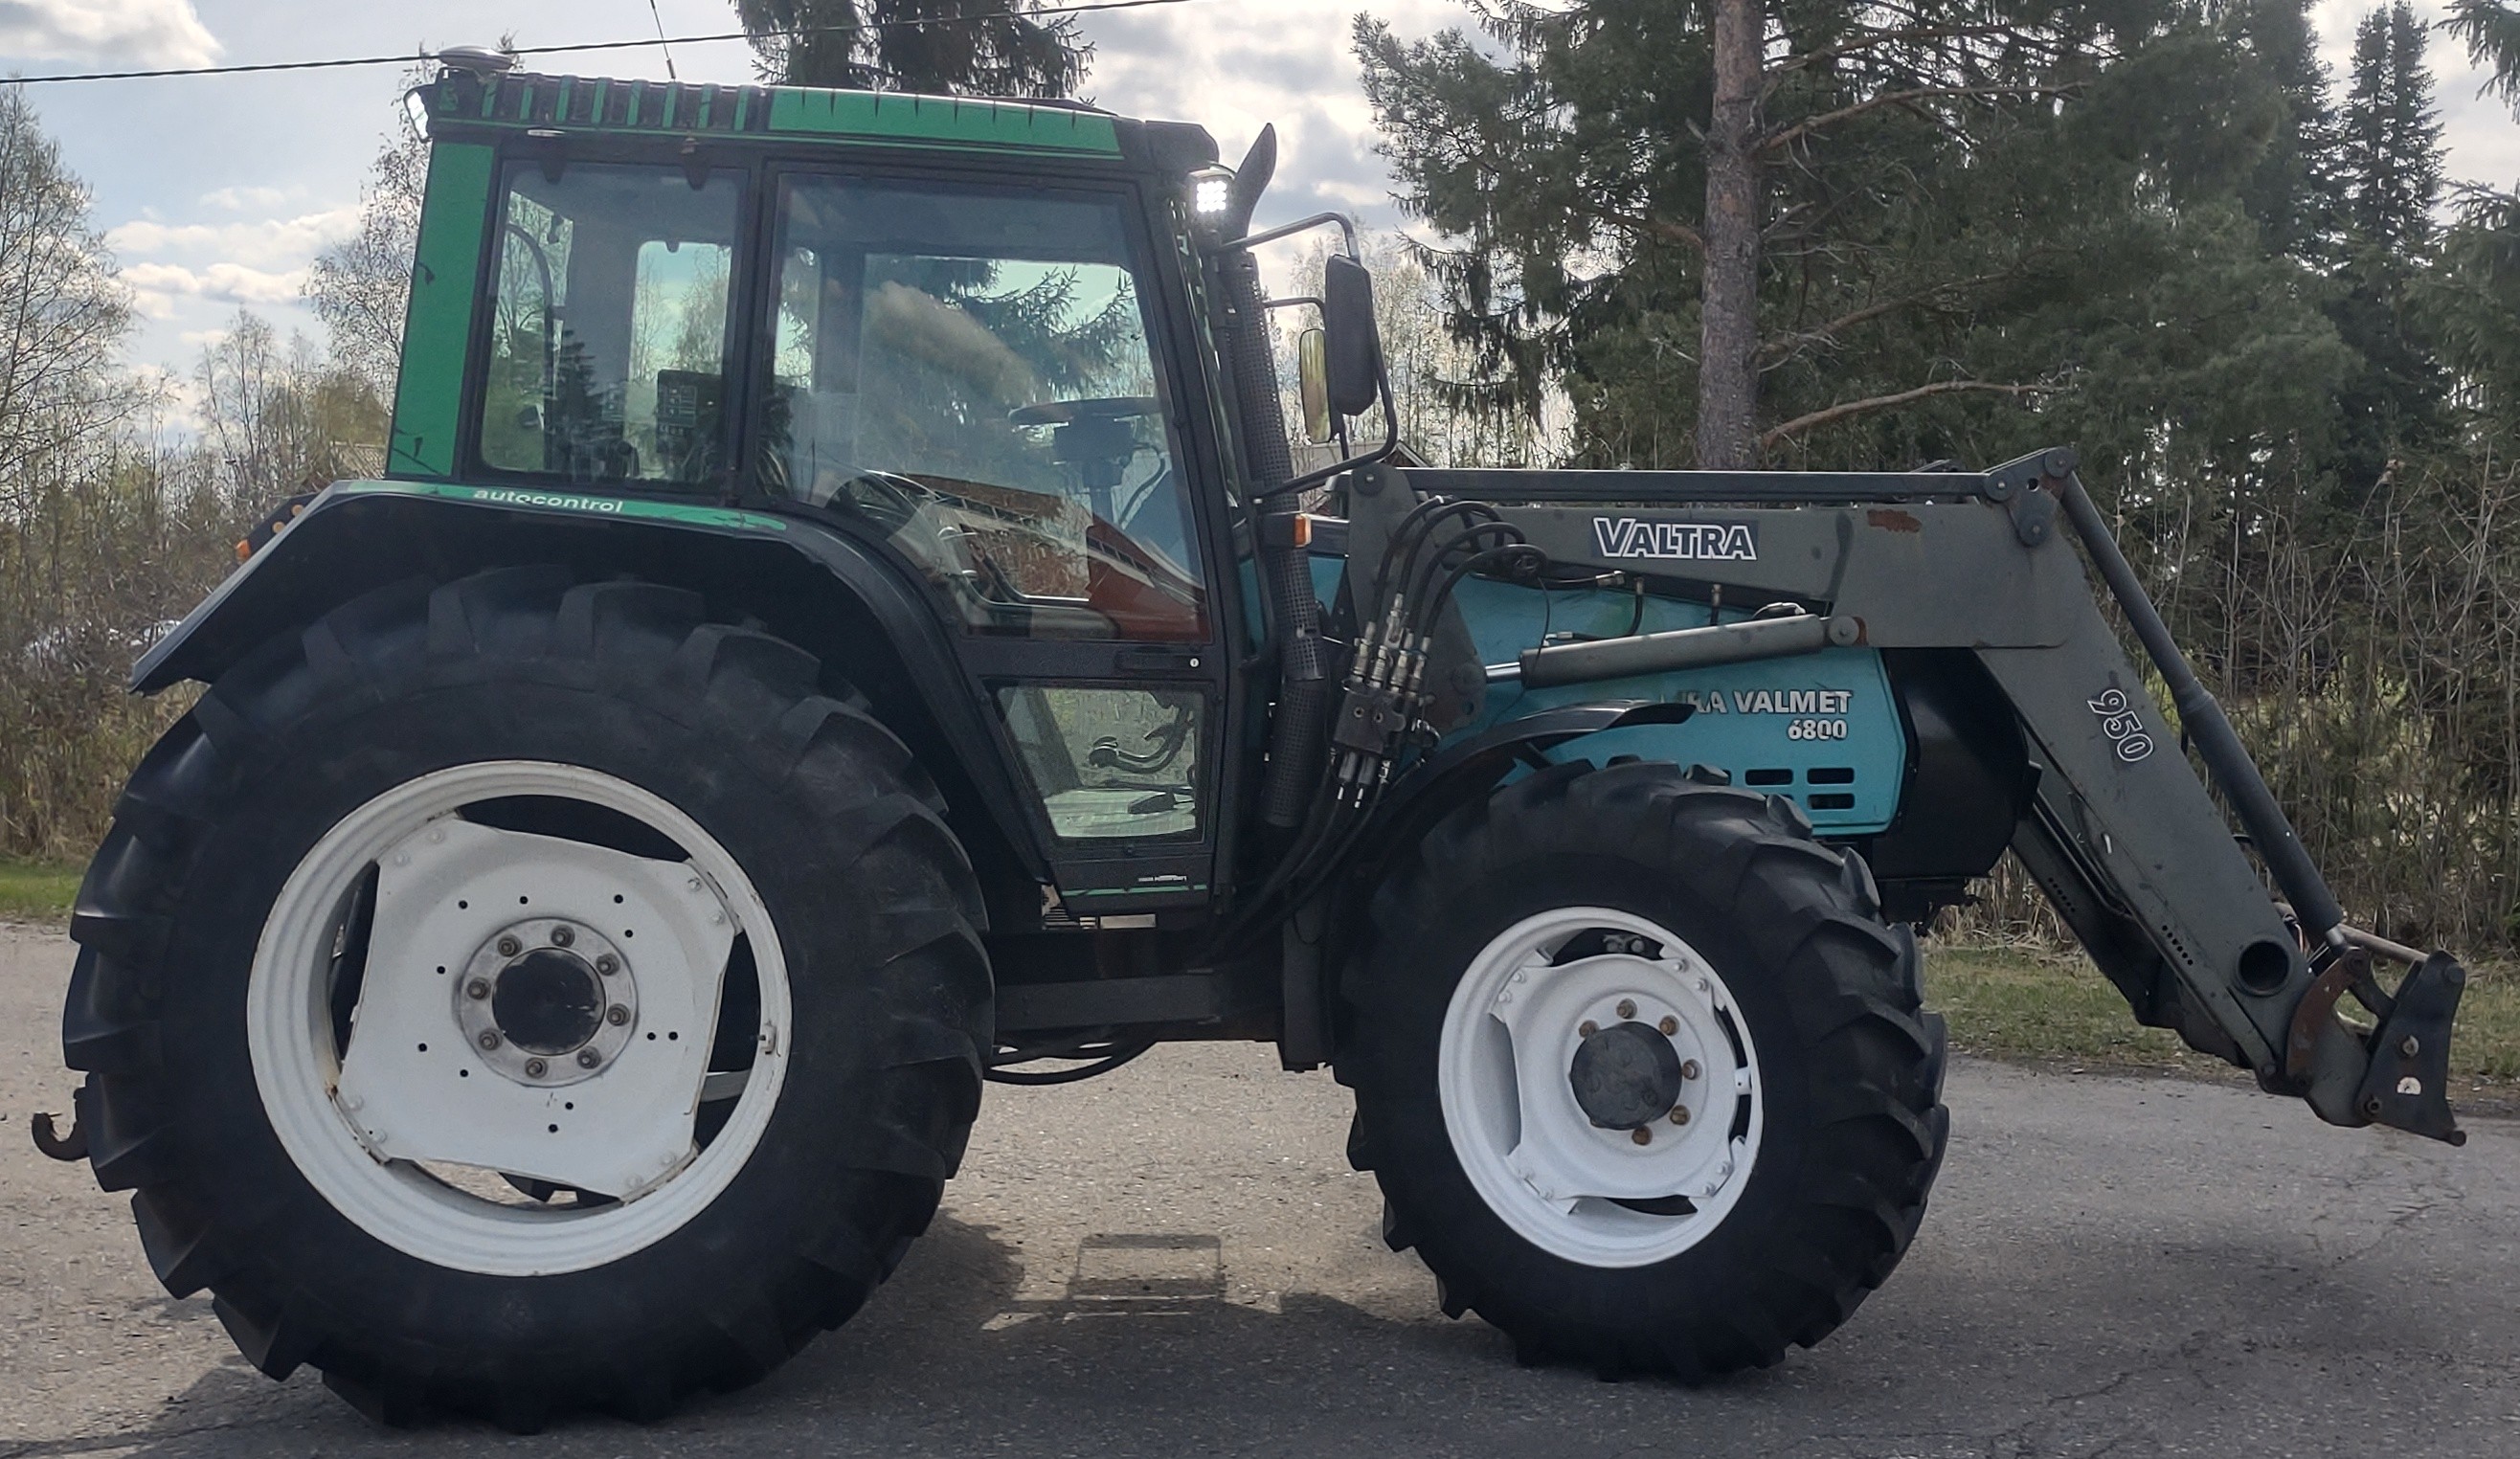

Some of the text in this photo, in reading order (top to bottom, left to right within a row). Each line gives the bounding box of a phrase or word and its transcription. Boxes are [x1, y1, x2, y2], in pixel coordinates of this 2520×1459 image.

[474, 489, 623, 512] autocontrol
[1593, 517, 1757, 560] VALTRA
[1733, 690, 1852, 713] VALMET
[1788, 719, 1848, 740] 6800
[2087, 689, 2153, 761] 950
